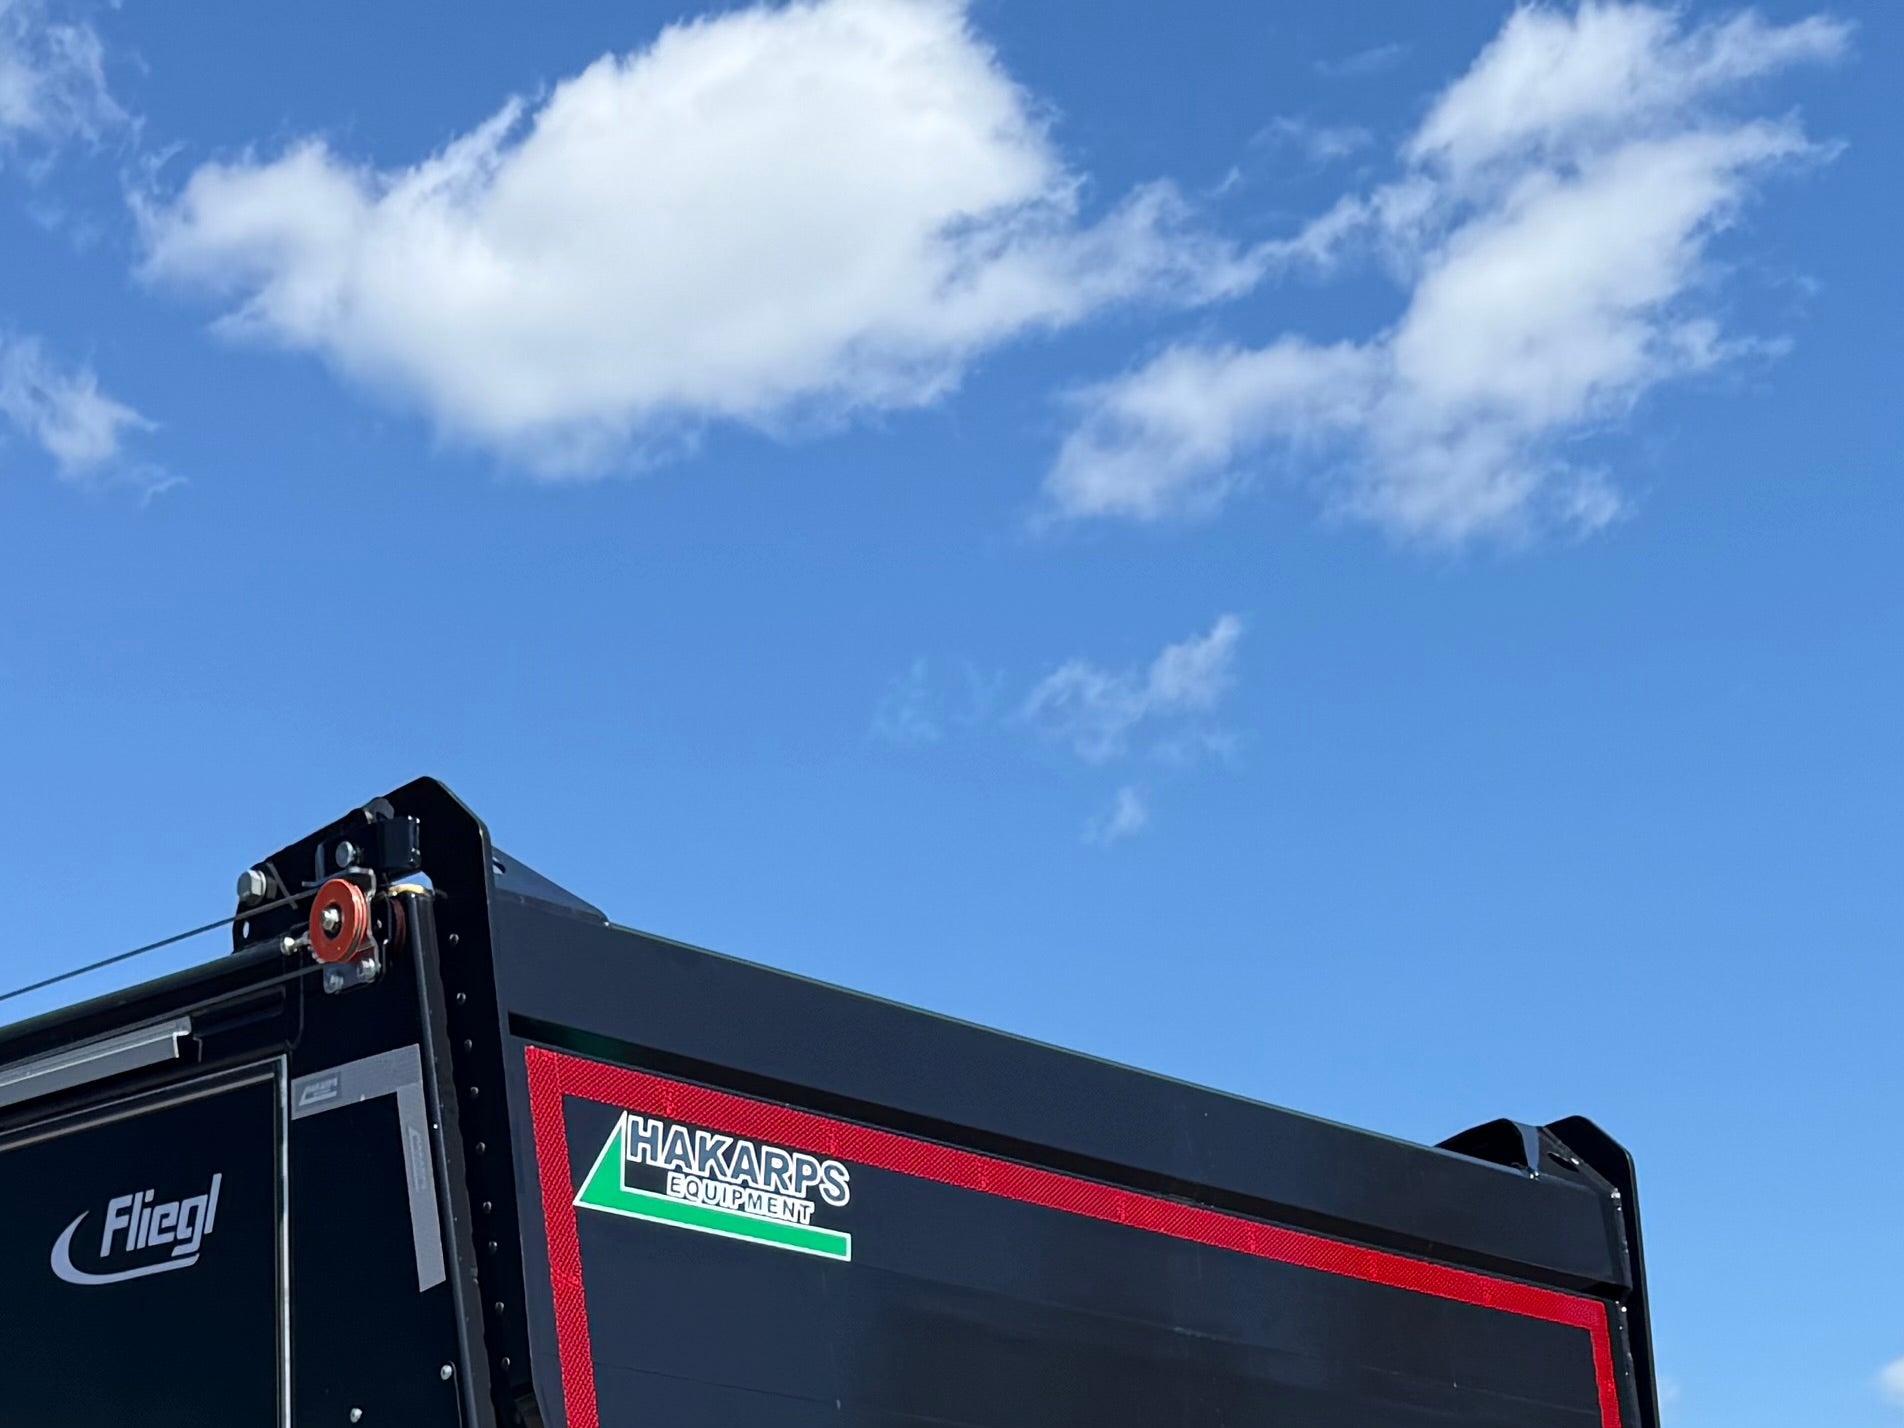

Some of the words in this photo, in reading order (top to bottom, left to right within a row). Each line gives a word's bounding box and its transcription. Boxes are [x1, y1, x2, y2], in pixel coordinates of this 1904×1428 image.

[626, 1114, 850, 1206] HAKARPS
[667, 1172, 814, 1224] EQUIPMENT
[100, 1173, 222, 1257] Fliegl
